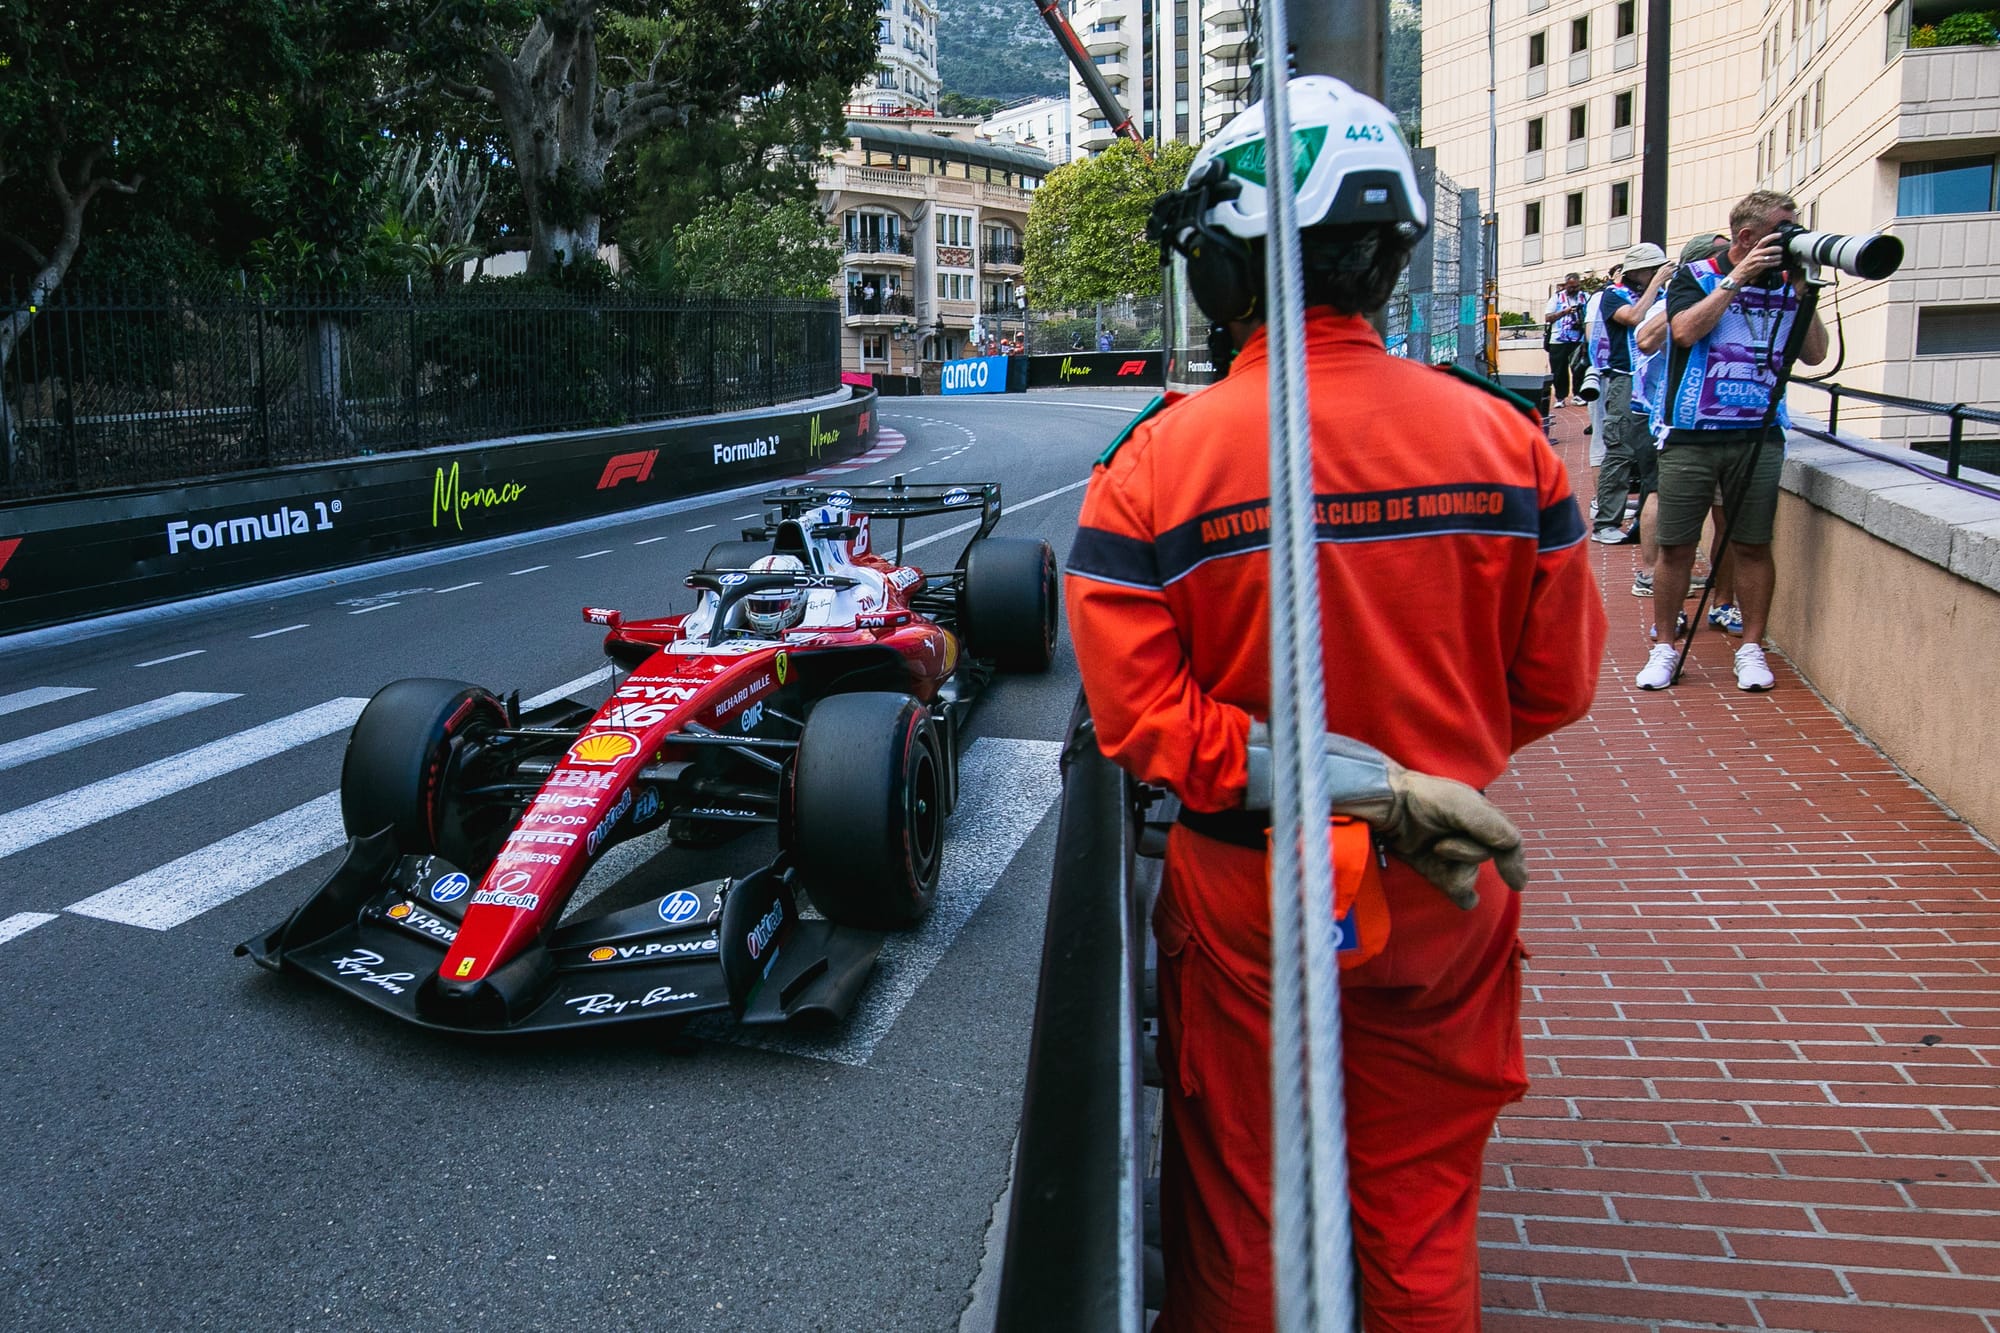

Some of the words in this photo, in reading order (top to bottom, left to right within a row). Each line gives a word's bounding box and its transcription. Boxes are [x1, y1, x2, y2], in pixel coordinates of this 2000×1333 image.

[1345, 124, 1385, 142] 443
[1060, 357, 1092, 382] Monaco
[1188, 361, 1212, 372] Formula
[810, 413, 841, 459] Monaco
[713, 437, 768, 465] Formula
[432, 461, 527, 531] Monaco
[1201, 505, 1326, 543] AUTOME
[1328, 501, 1381, 525] CLUB
[1387, 497, 1413, 521] DE
[1419, 491, 1504, 516] MONACO
[167, 506, 310, 554] Formula
[853, 516, 869, 556] 16
[722, 574, 746, 585] hp
[794, 576, 834, 587] DXC
[859, 595, 876, 612] ZYN
[590, 614, 608, 623] ZYN
[860, 617, 885, 626] ZYN
[627, 676, 712, 684] Bitdefender
[613, 686, 699, 700] ZYN
[716, 687, 748, 717] RICHARD
[749, 673, 771, 694] MILLE
[591, 702, 681, 727] 16
[546, 769, 618, 789] IBM
[522, 814, 587, 825] WHOOP
[507, 830, 577, 847] PIRELLI
[435, 873, 467, 902] hp
[471, 890, 538, 910] UniCredit
[661, 891, 699, 922] hp
[405, 911, 457, 941] V-Pow
[618, 939, 717, 959] V-Powe
[332, 949, 416, 995] Ray-Ban
[565, 986, 698, 1015] Ray-Ban
